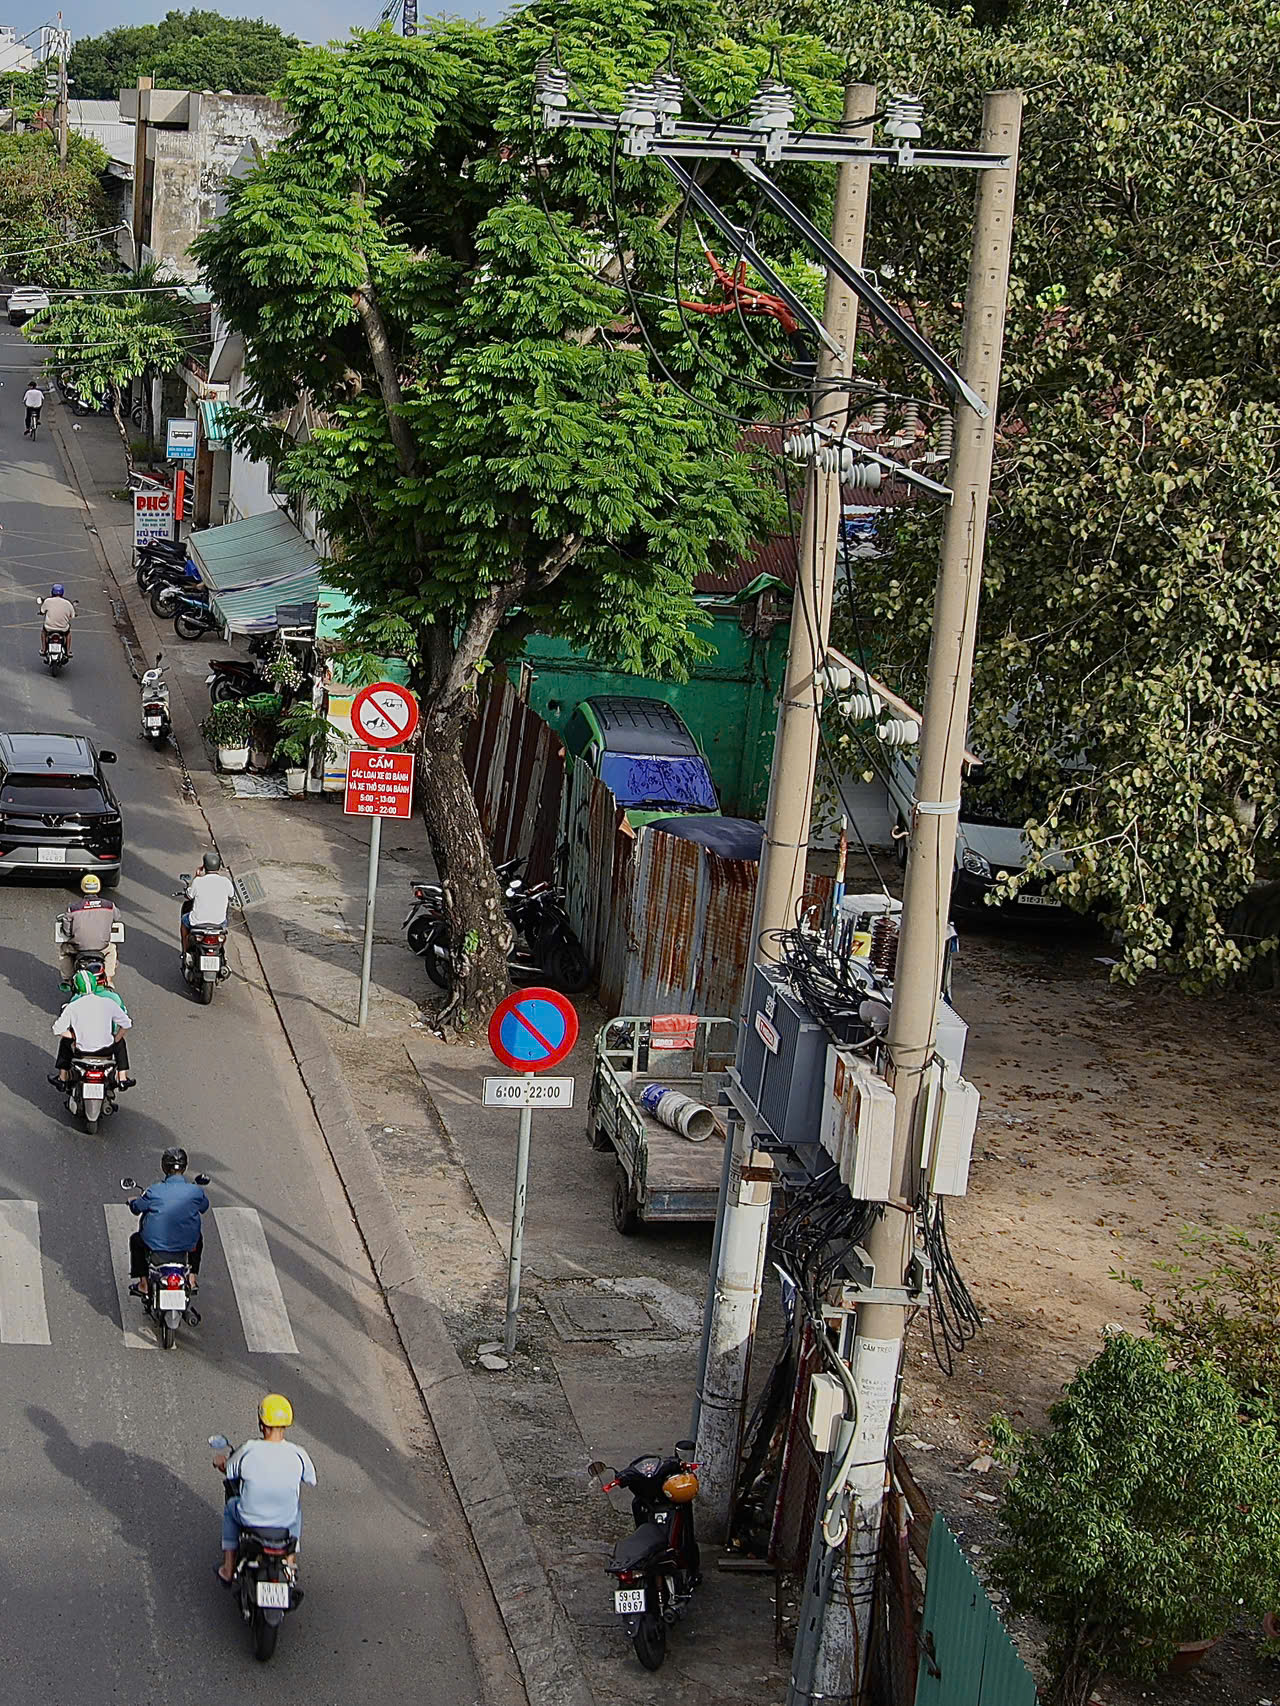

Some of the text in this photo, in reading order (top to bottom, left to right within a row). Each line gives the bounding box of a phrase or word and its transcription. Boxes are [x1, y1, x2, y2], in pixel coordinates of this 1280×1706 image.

[136, 491, 170, 511] PHỞ
[368, 754, 394, 769] CẤM
[351, 768, 363, 778] CÁC
[363, 770, 376, 780] LOẠI
[377, 771, 385, 780] XE
[392, 771, 409, 781] BÁNH
[349, 780, 357, 790] VÀ
[357, 782, 365, 791] XE
[393, 783, 410, 794] BÁNH
[360, 793, 374, 802] 5:00
[380, 795, 396, 804] 13:00
[357, 804, 374, 813] 16:00
[379, 806, 397, 814] 22:00
[495, 1085, 521, 1099] 6:00
[529, 1086, 560, 1099] 22:00
